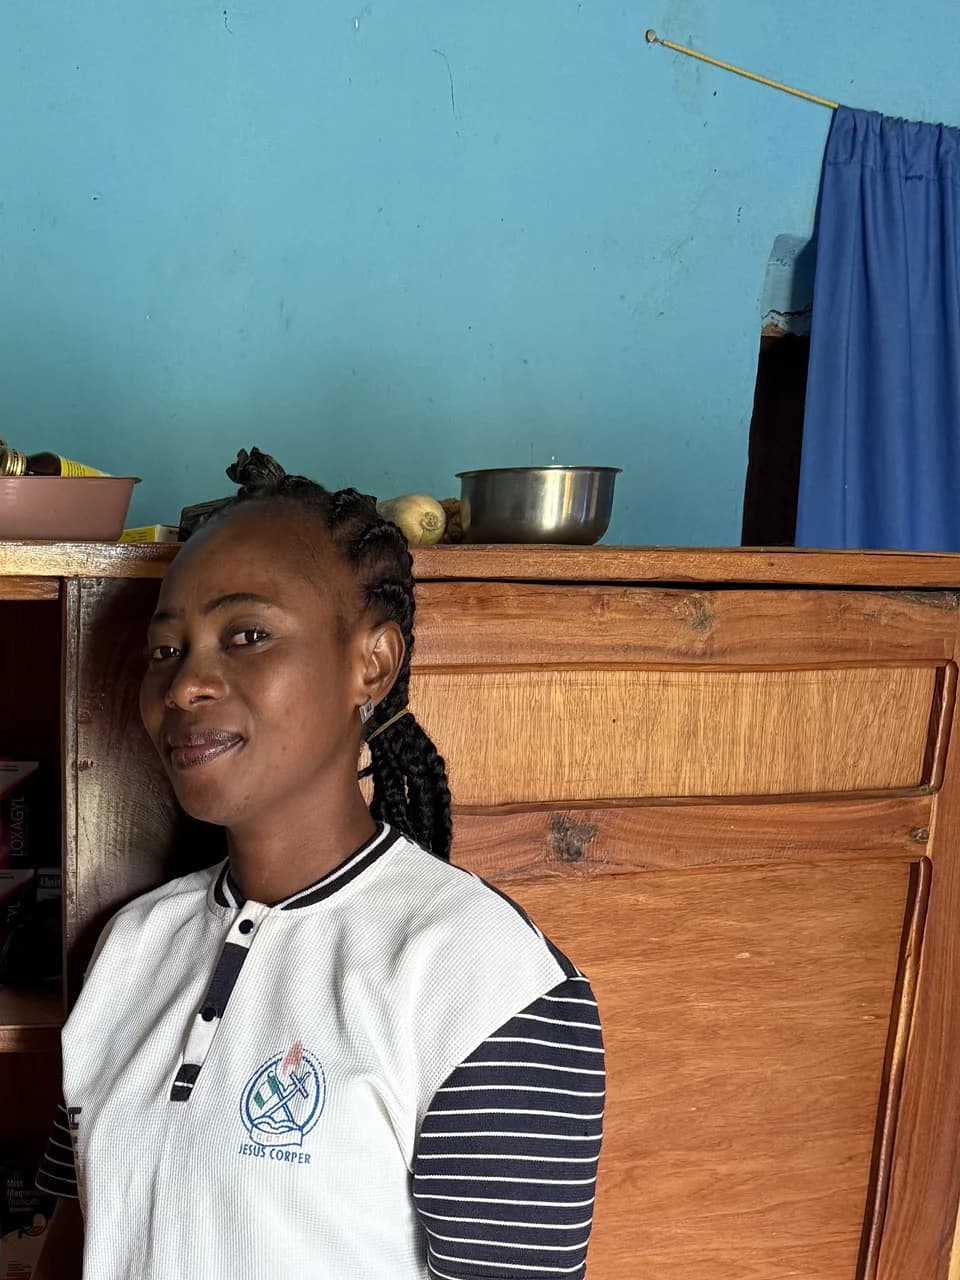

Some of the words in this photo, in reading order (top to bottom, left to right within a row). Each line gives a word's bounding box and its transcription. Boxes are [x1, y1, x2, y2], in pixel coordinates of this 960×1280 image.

[10, 792, 26, 857] LOXAGYL
[238, 1143, 266, 1158] JESUS
[269, 1148, 312, 1164] CORPER
